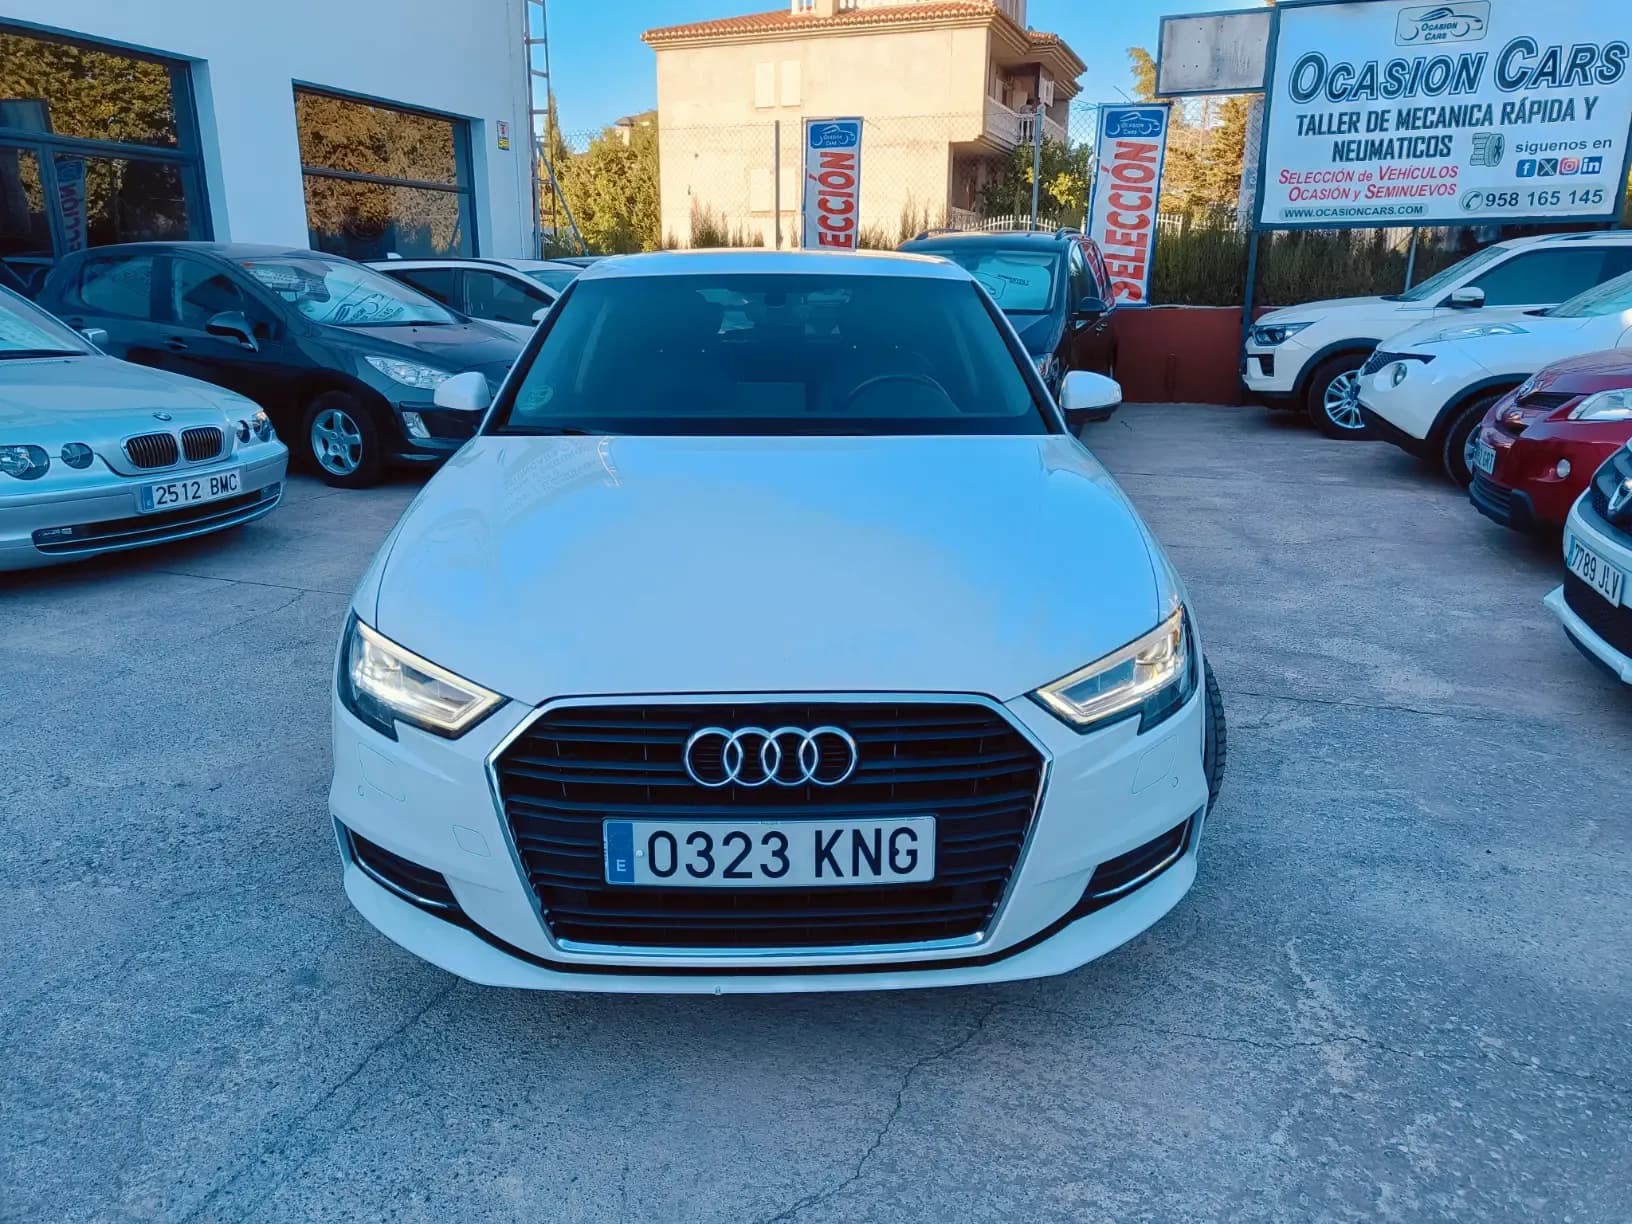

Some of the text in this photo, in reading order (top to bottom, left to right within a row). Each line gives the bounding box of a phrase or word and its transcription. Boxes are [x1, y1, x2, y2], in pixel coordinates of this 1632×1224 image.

[1288, 36, 1629, 104] OCASION CARS
[1296, 96, 1599, 136] TALLER DE MECANICA RÁPIDA Y
[1332, 135, 1453, 162] NEUMATICOS
[1515, 137, 1612, 153] siguenos en
[1358, 170, 1373, 182] de
[1352, 190, 1361, 202] y
[1365, 183, 1457, 199] SEMINUEVOS
[1485, 189, 1603, 207] 958 165 145
[1101, 141, 1159, 301] SELECCIÓN
[1284, 206, 1423, 217] WWW.OCASIONCARS.COM
[156, 473, 237, 505] 2512 BMC
[1572, 543, 1620, 599] 7789 JLV
[616, 859, 627, 872] E
[647, 830, 790, 879] 0323
[813, 827, 919, 878] KNG
